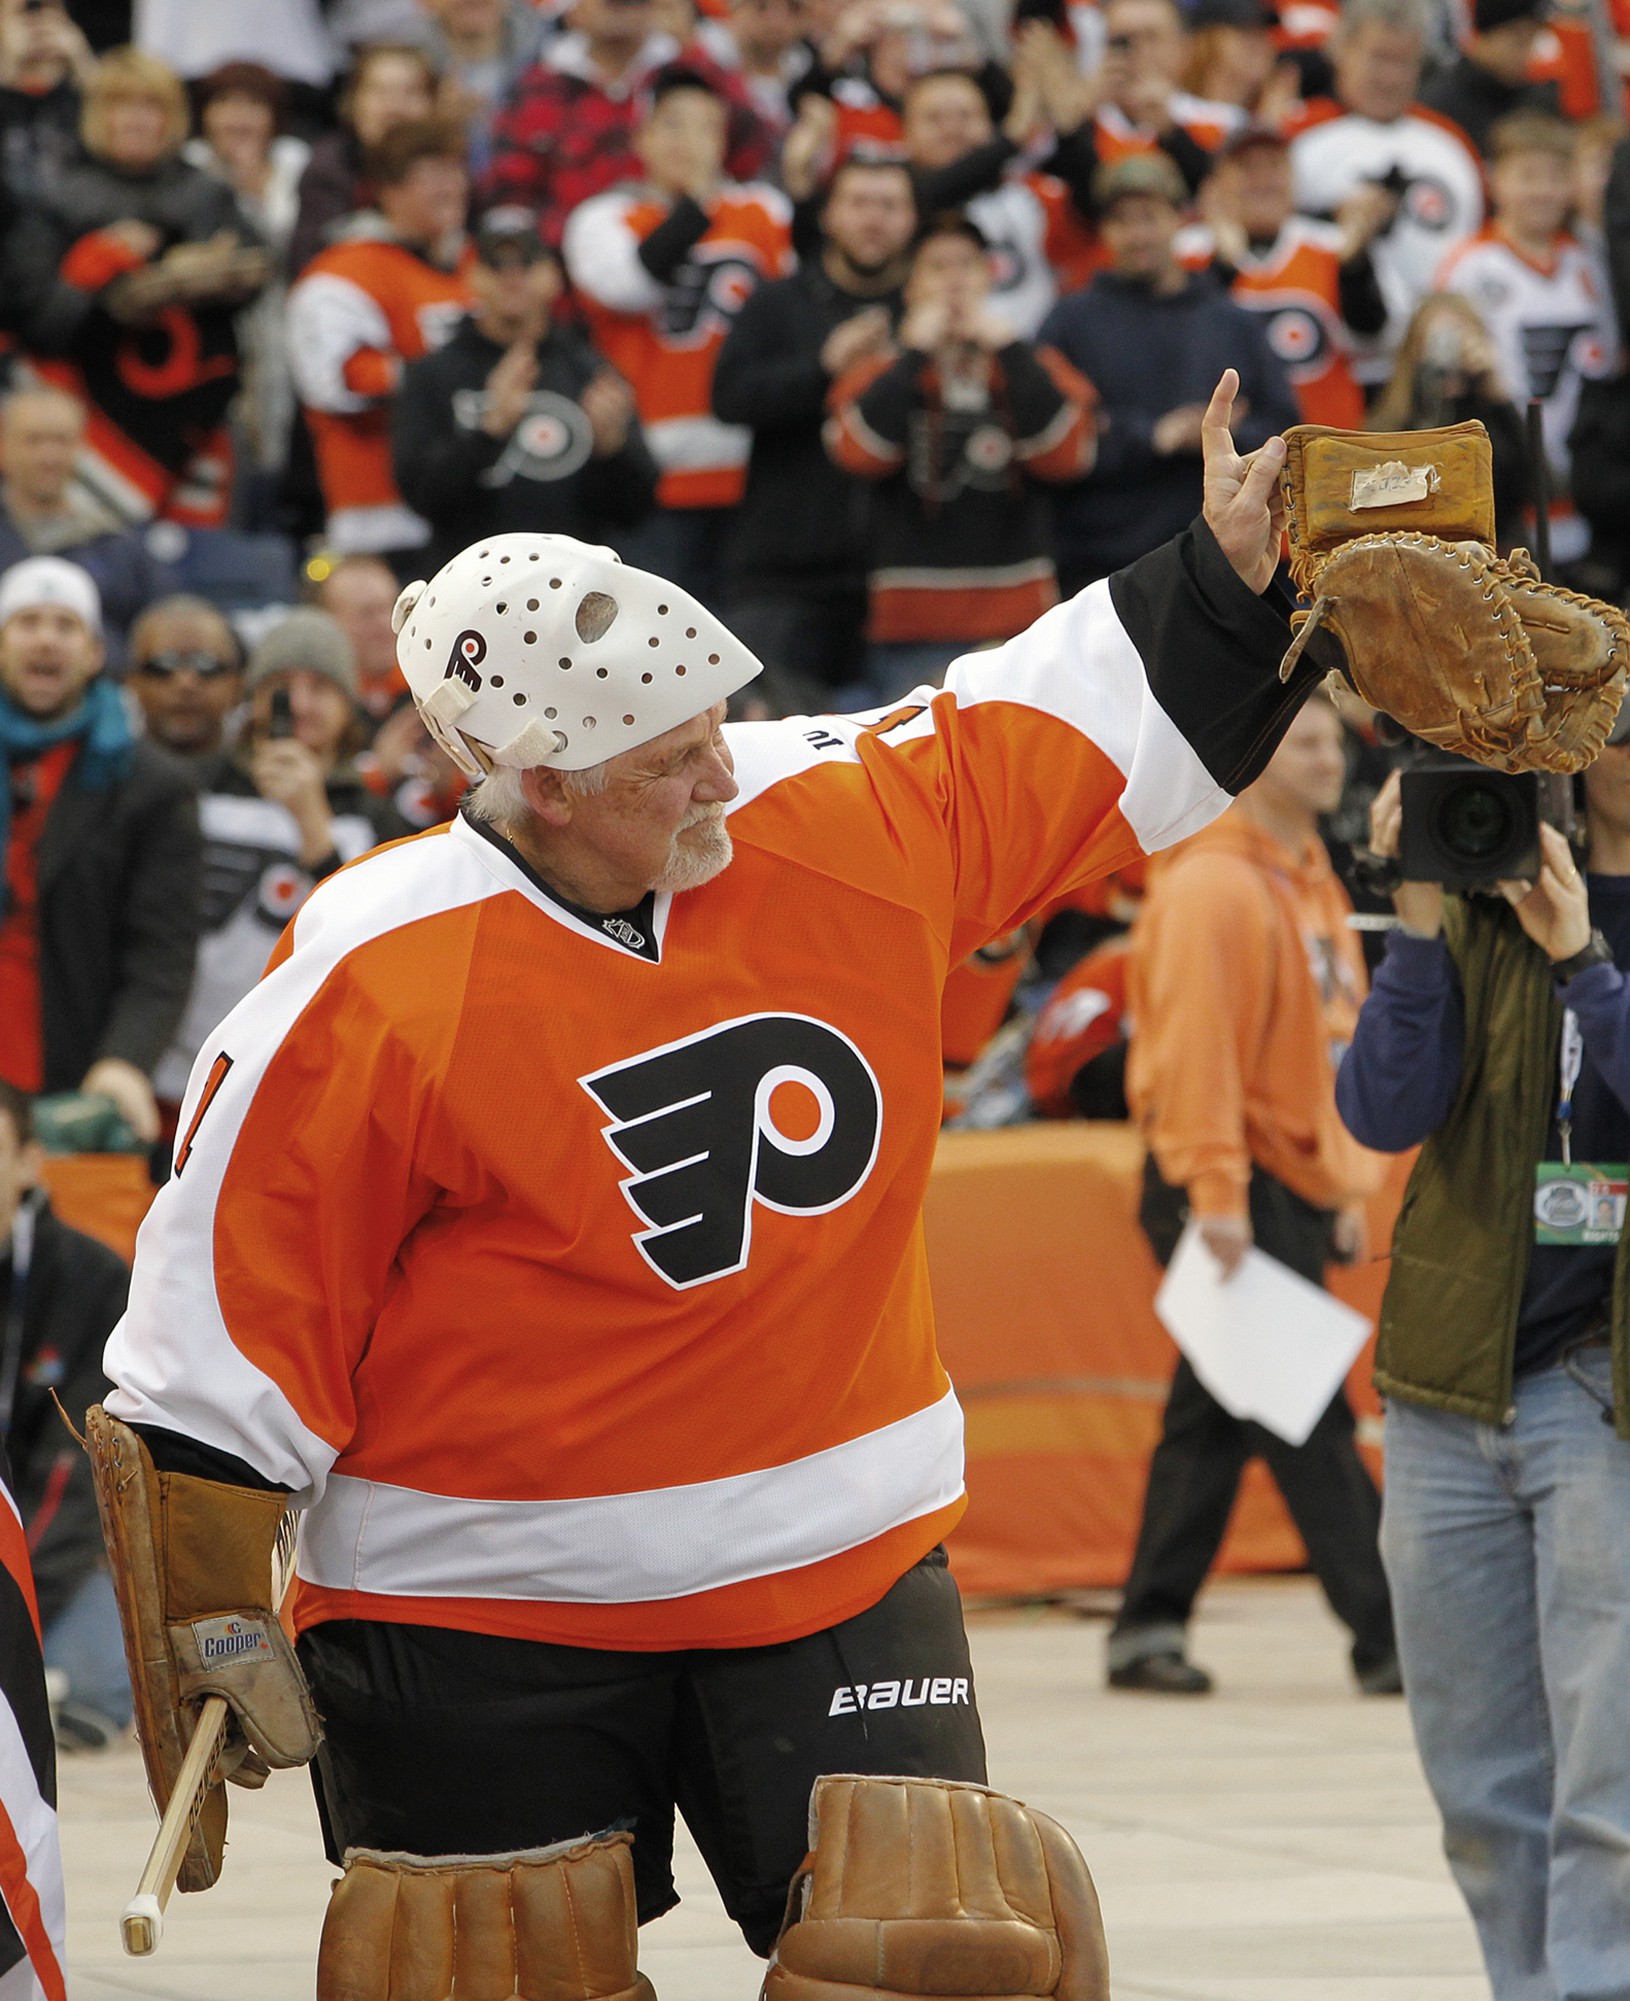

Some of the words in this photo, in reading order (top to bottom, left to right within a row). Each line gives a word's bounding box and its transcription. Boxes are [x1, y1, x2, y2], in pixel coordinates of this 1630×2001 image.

[175, 1050, 235, 1179] 1
[205, 1633, 261, 1657] Cooper
[828, 1678, 969, 1716] BAUER
